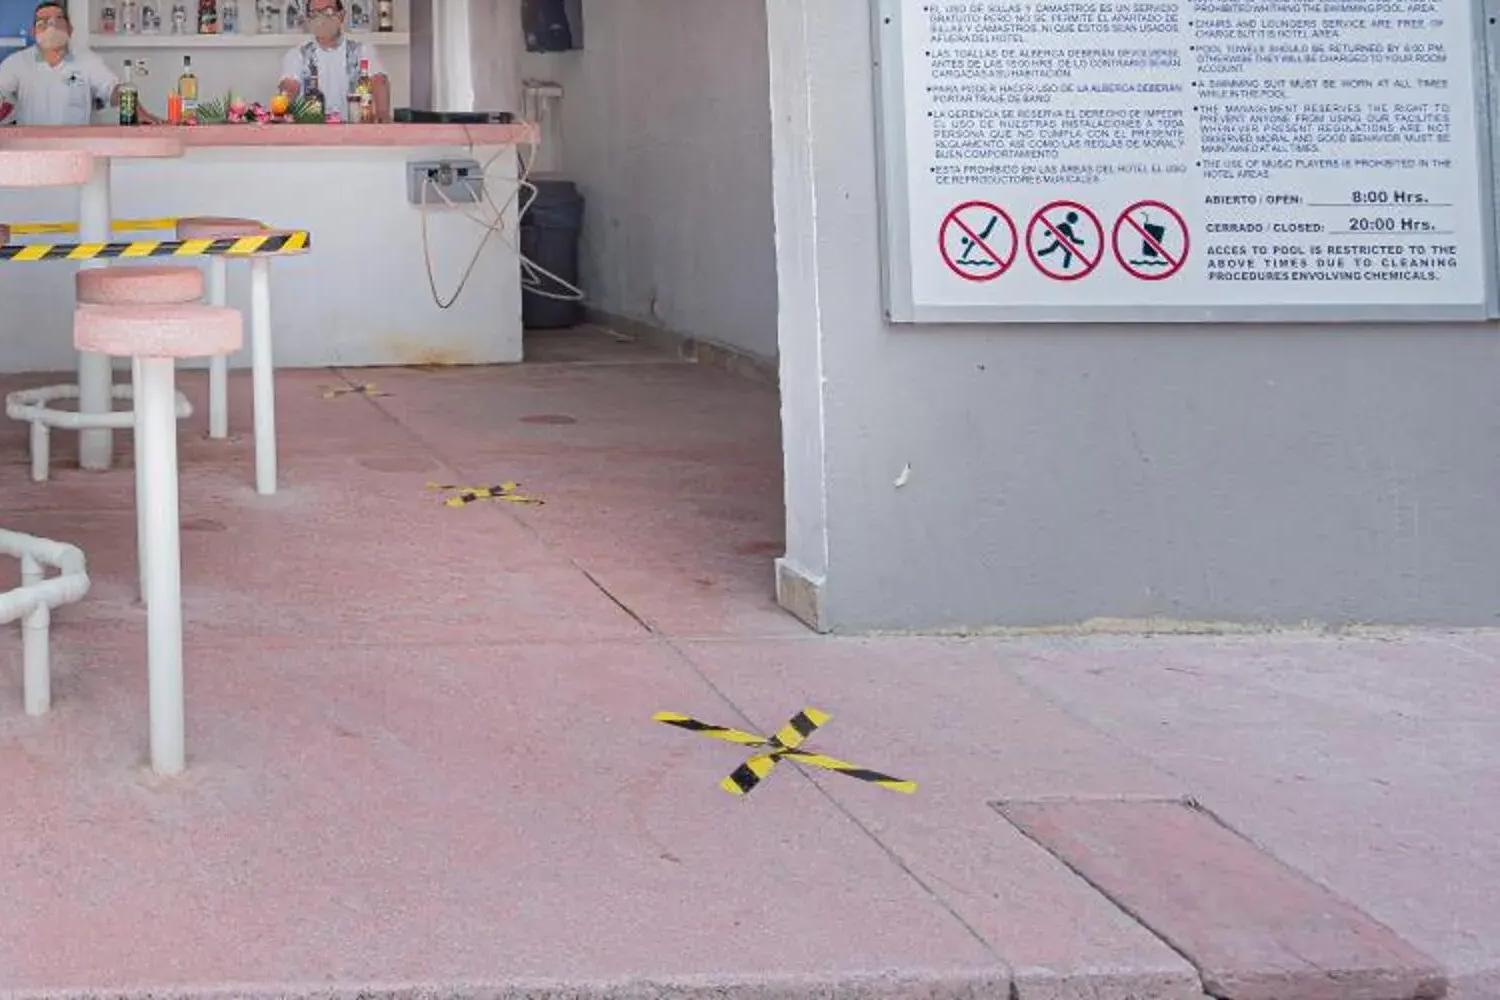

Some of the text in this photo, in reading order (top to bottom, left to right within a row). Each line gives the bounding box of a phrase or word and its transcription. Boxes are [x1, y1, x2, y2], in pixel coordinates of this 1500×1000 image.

[1205, 194, 1257, 205] ABIERTO
[1265, 194, 1304, 205] OPEN:
[1351, 190, 1429, 204] 8:00 Hrs.
[1205, 223, 1264, 233] CERRADO
[1272, 223, 1325, 233] CLOSED:
[1348, 217, 1436, 231] 20:00 Hrs.
[1207, 245, 1457, 255] ACCES TO POOL IS RESTRICTED TO THE
[1207, 258, 1457, 268] ABOVE TIMES DUE TO CLEANING
[1208, 271, 1440, 281] PROCEDURES ENVOLVING CHEMICALS.
